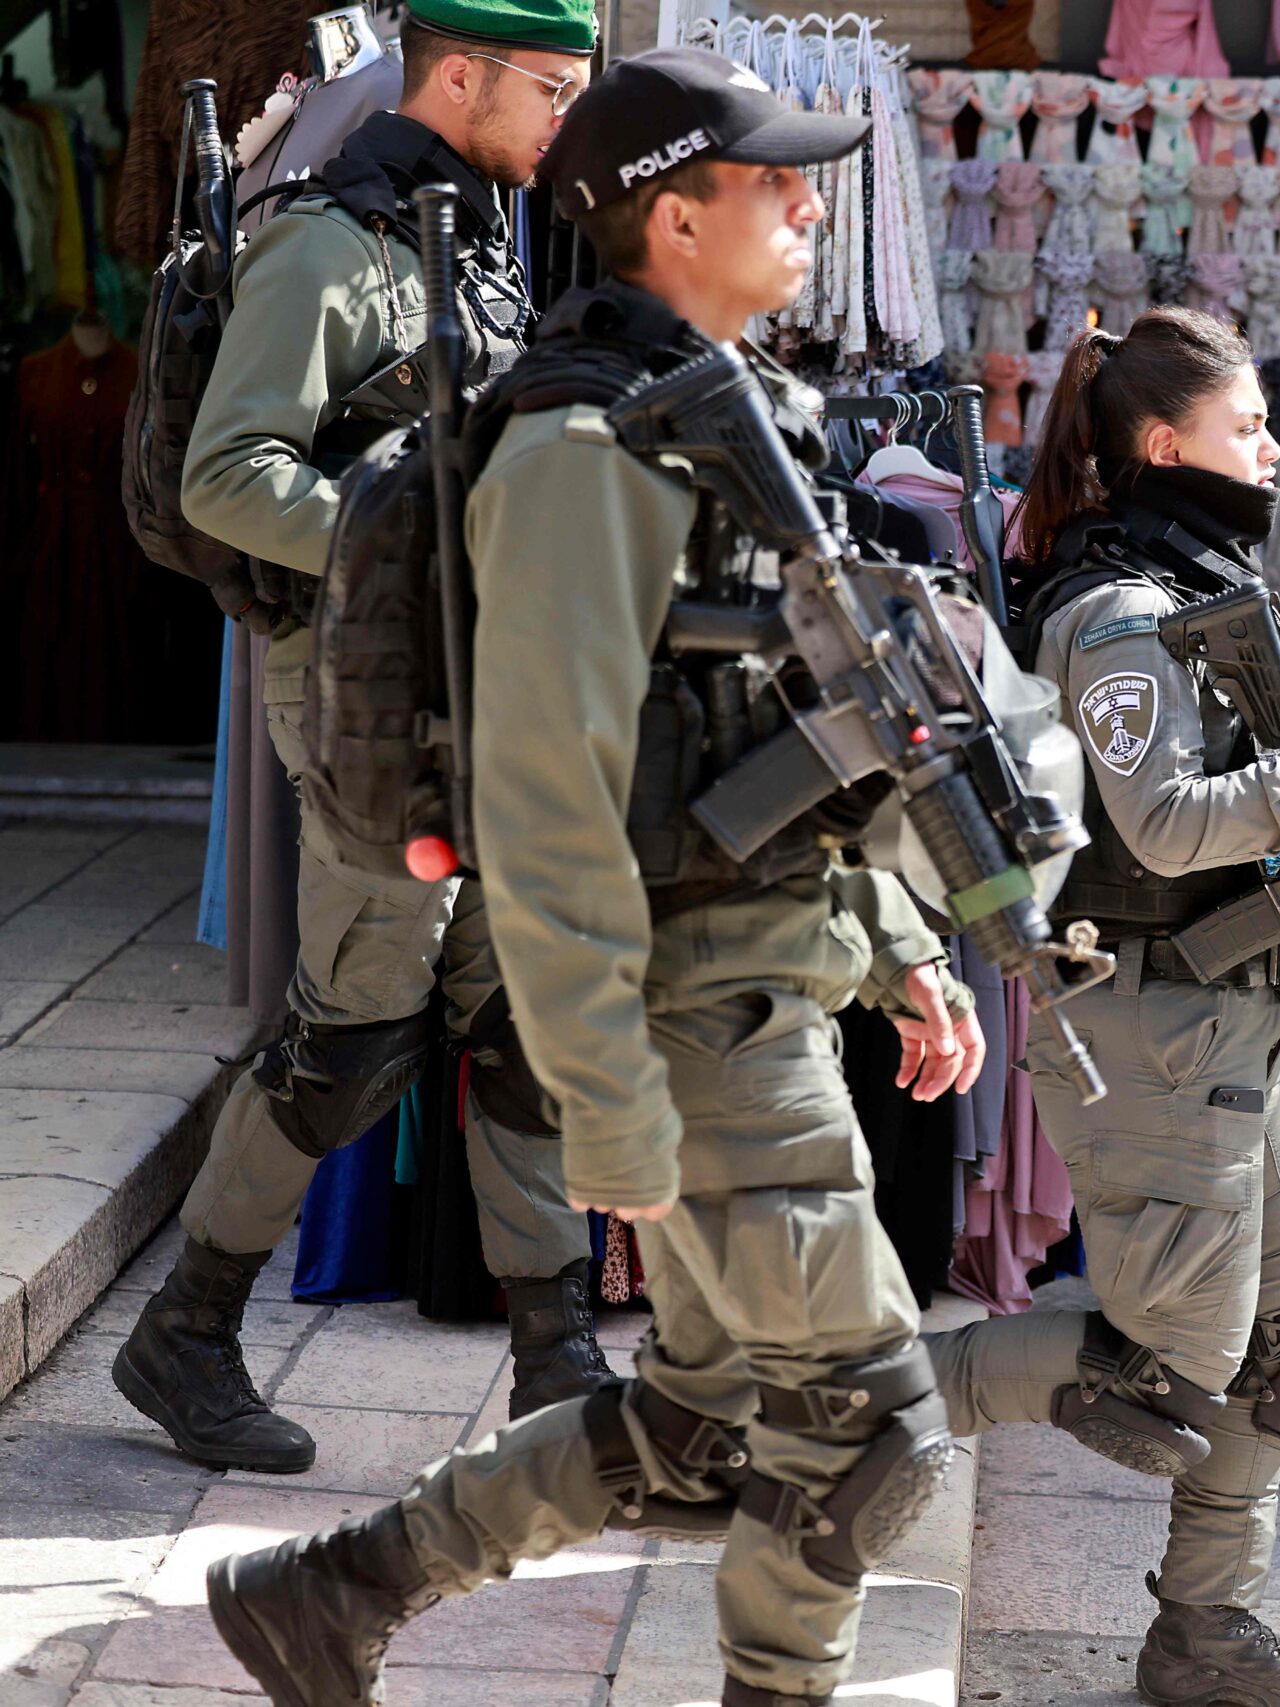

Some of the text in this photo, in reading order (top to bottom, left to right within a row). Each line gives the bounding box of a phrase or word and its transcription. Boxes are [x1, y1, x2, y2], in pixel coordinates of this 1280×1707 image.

[618, 128, 710, 188] POLICE
[1084, 628, 1107, 644] ZEHAVA
[1127, 619, 1150, 629] COHEN
[1083, 685, 1109, 711] ישראל
